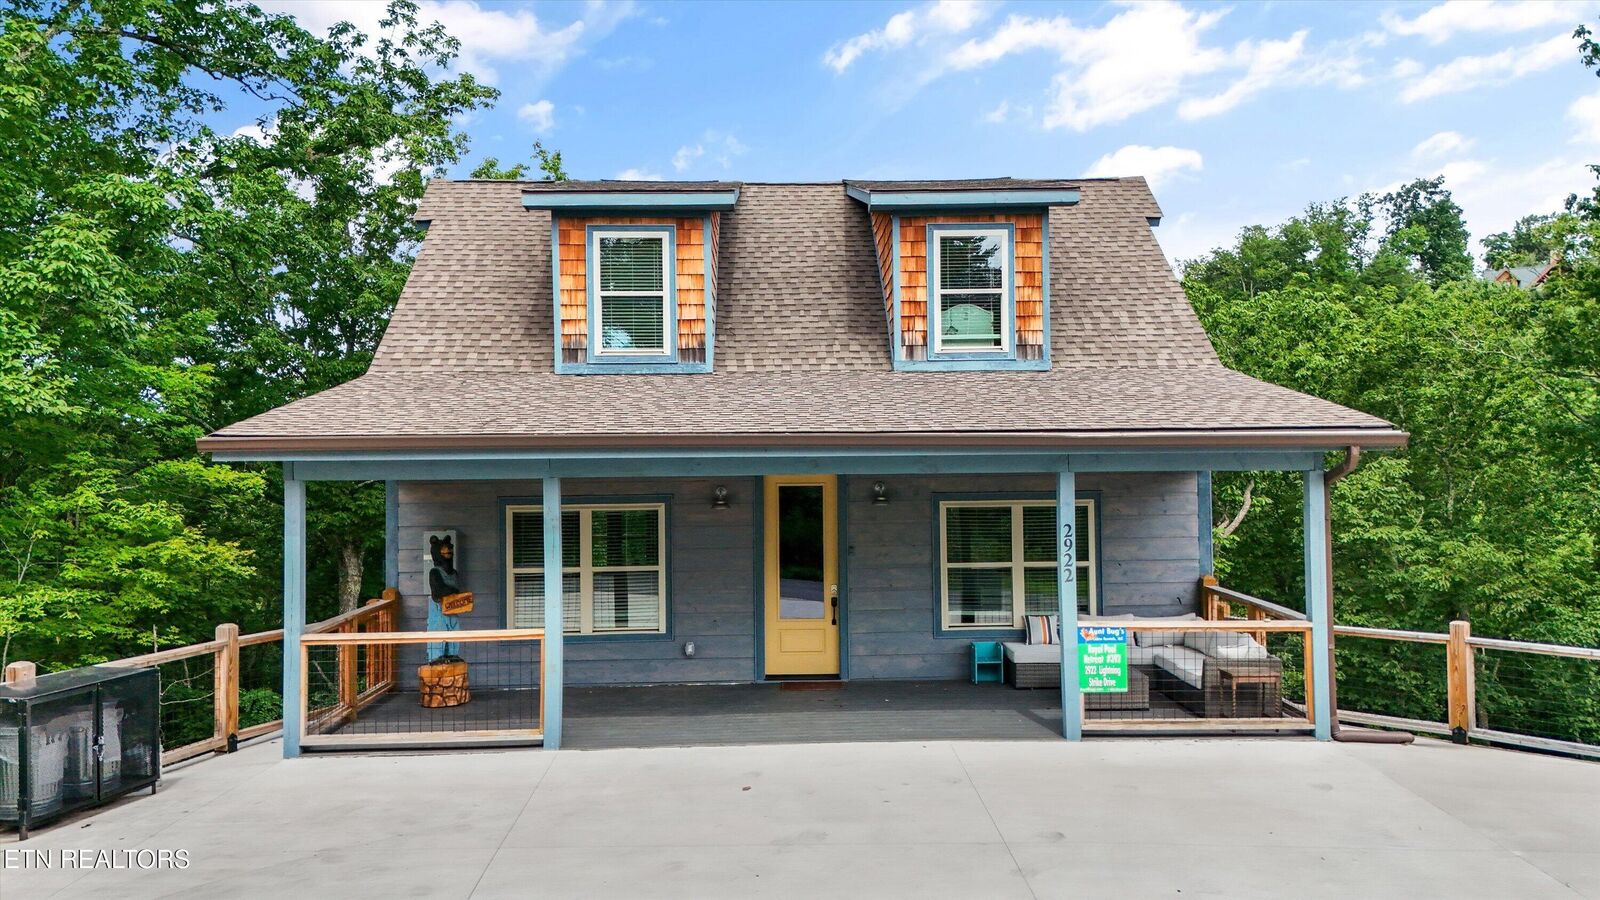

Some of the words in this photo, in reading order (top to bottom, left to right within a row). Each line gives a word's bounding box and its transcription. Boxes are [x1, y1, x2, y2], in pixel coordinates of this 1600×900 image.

[1063, 523, 1073, 583] 2922
[1089, 627, 1104, 635] Aunt
[1106, 627, 1124, 637] Bug's
[1098, 665, 1121, 676] Lightning
[1088, 677, 1102, 687] Strike
[1103, 677, 1116, 686] Drive
